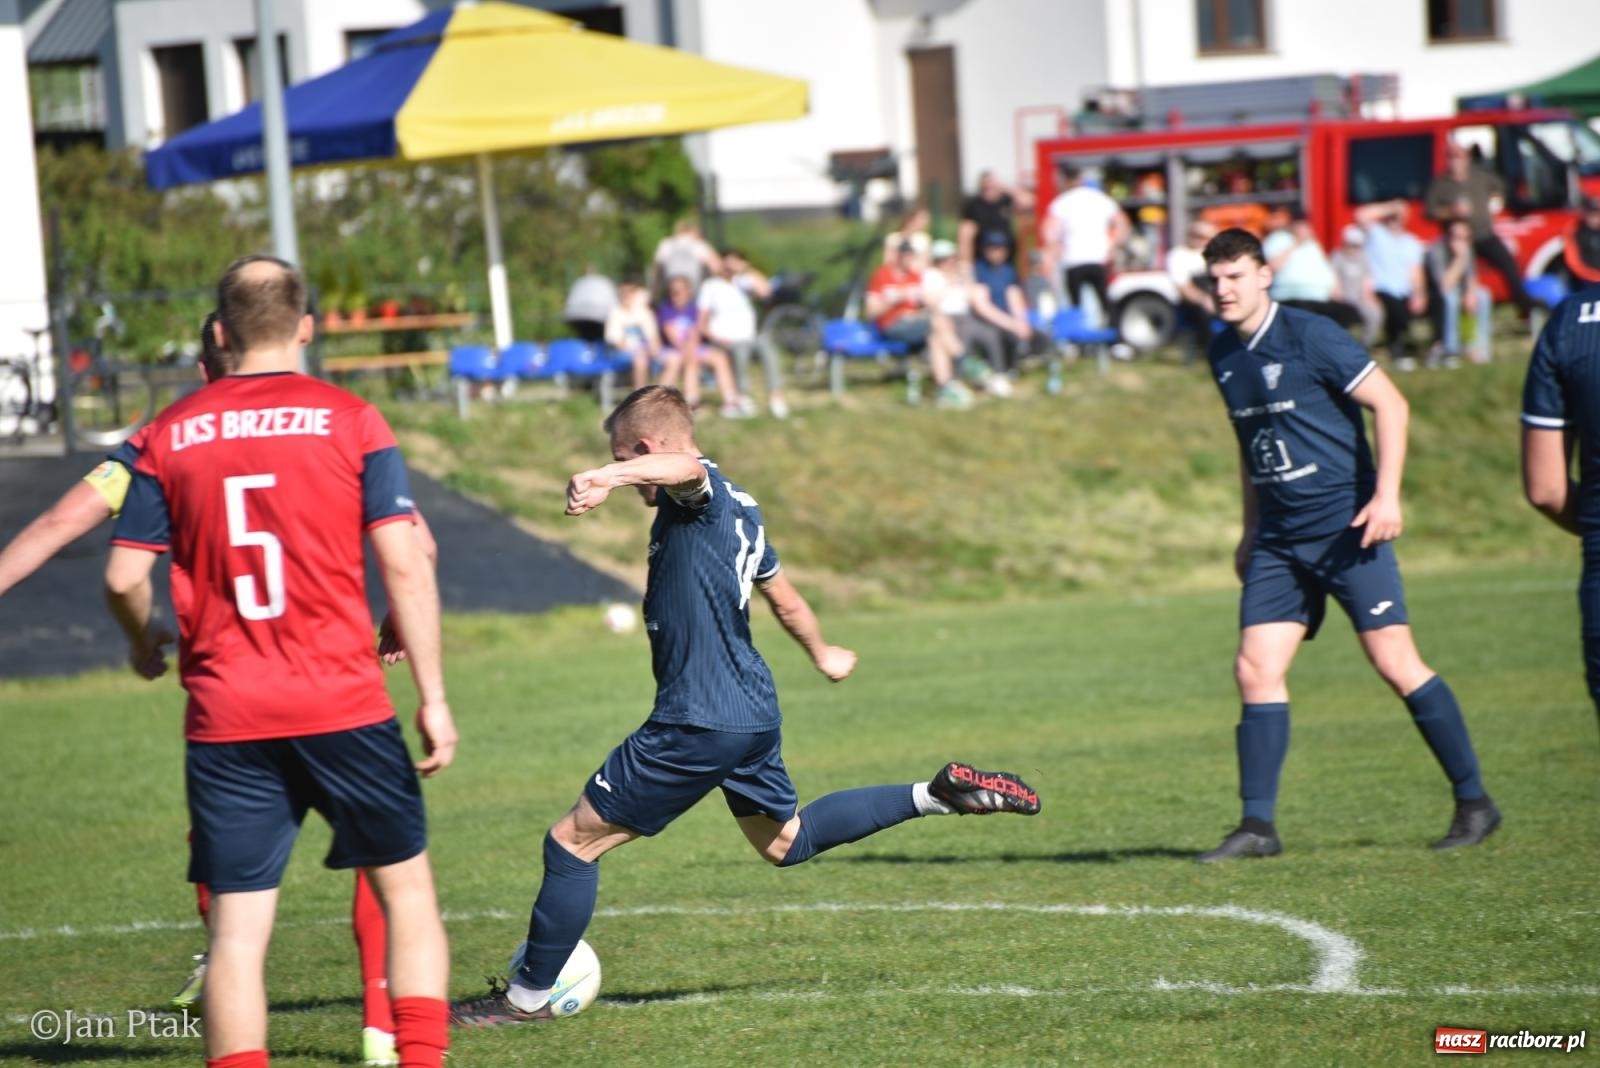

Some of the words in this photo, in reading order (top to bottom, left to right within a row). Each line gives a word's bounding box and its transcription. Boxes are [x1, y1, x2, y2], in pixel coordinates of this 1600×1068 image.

[171, 412, 216, 451] LKS
[221, 406, 332, 440] BRZEZIE
[223, 473, 286, 620] 5
